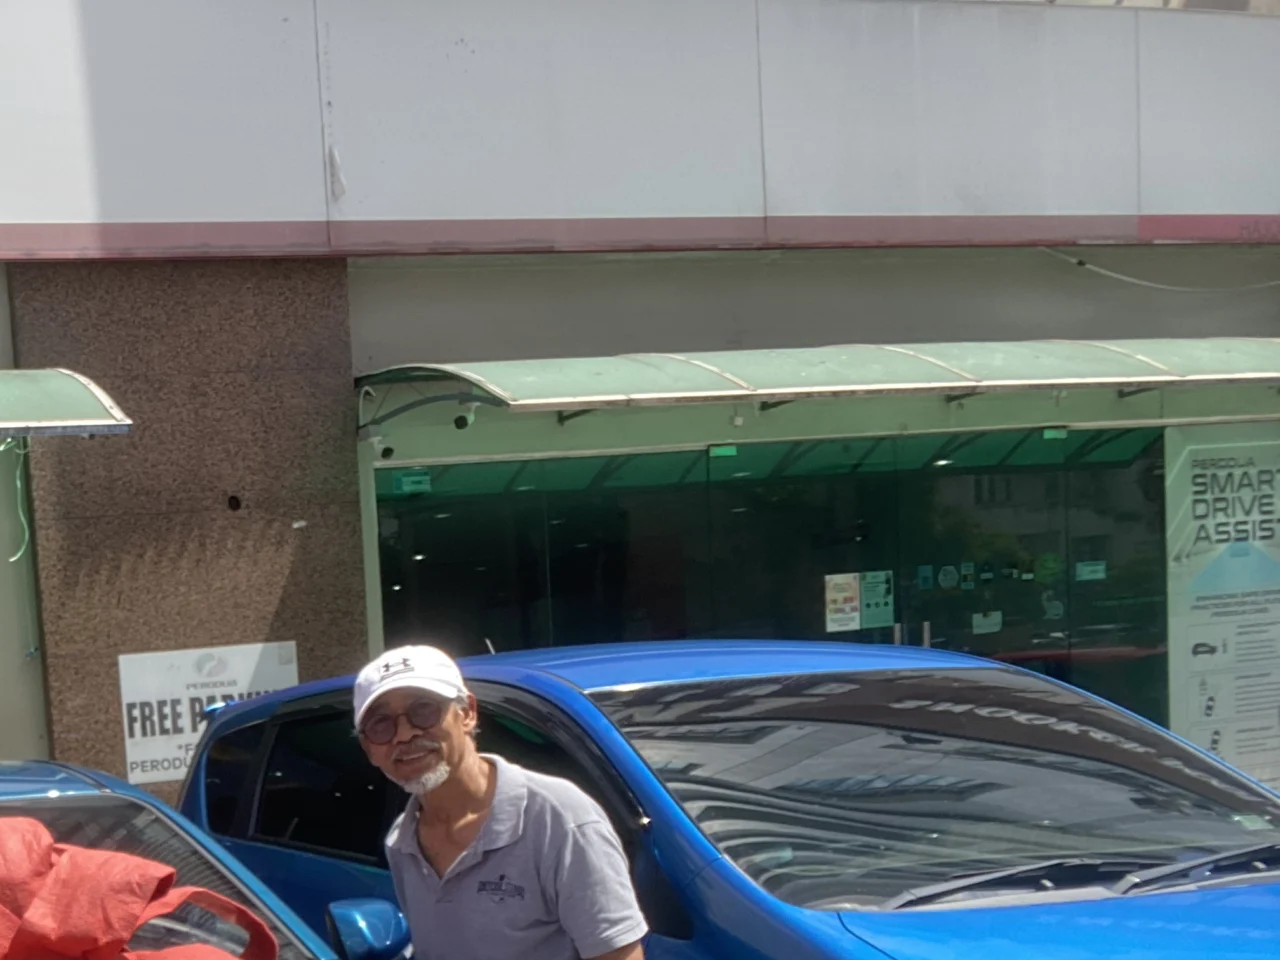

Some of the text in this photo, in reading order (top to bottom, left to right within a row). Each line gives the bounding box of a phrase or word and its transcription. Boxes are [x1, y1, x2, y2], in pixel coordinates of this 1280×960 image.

[1191, 469, 1280, 495] SMAR
[1192, 494, 1275, 520] DRIVE
[1193, 518, 1280, 546] ASSIS
[126, 699, 185, 739] FREE
